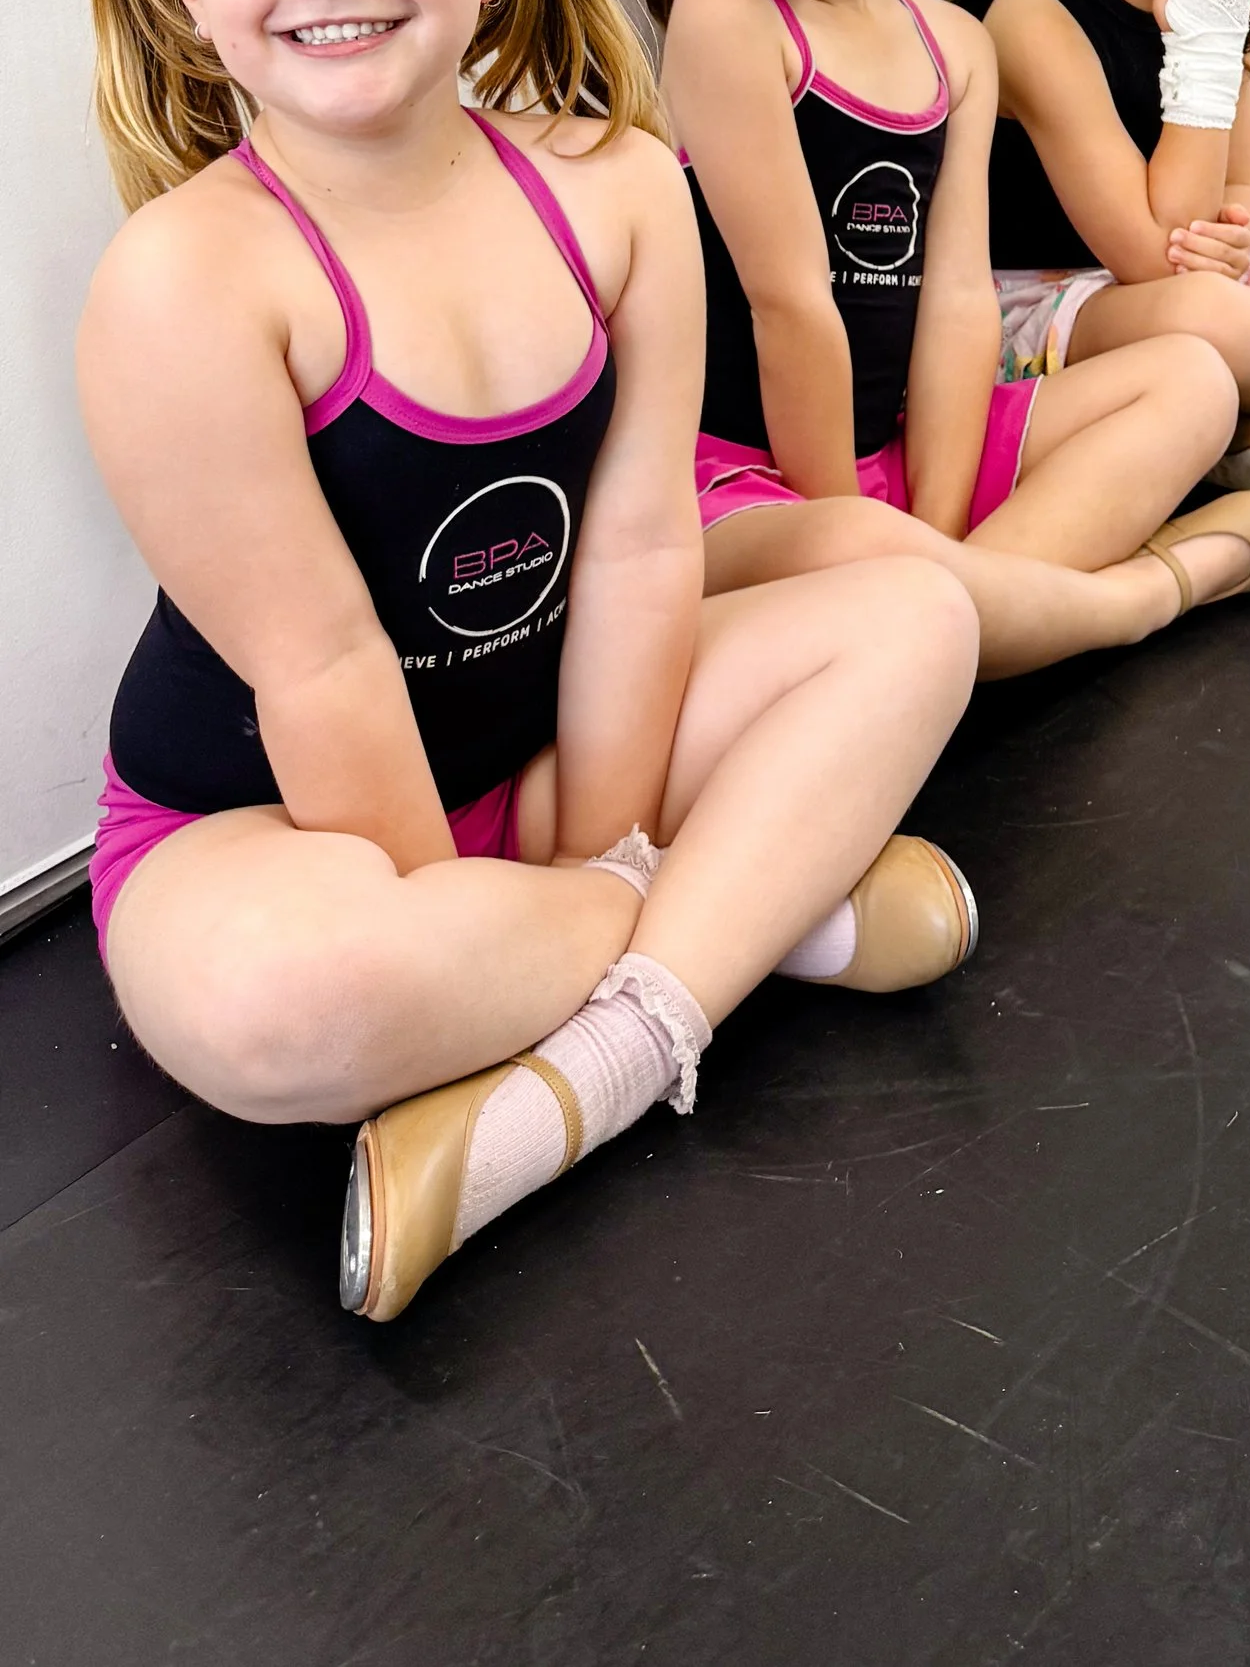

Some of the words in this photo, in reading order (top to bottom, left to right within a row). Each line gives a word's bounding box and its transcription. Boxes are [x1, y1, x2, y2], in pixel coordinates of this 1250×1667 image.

[852, 202, 908, 223] BPA
[853, 272, 899, 286] PERFORM
[447, 572, 503, 595] DANCE
[505, 551, 554, 578] STUDIO
[453, 531, 550, 579] BPA
[462, 624, 530, 662] PERFORM
